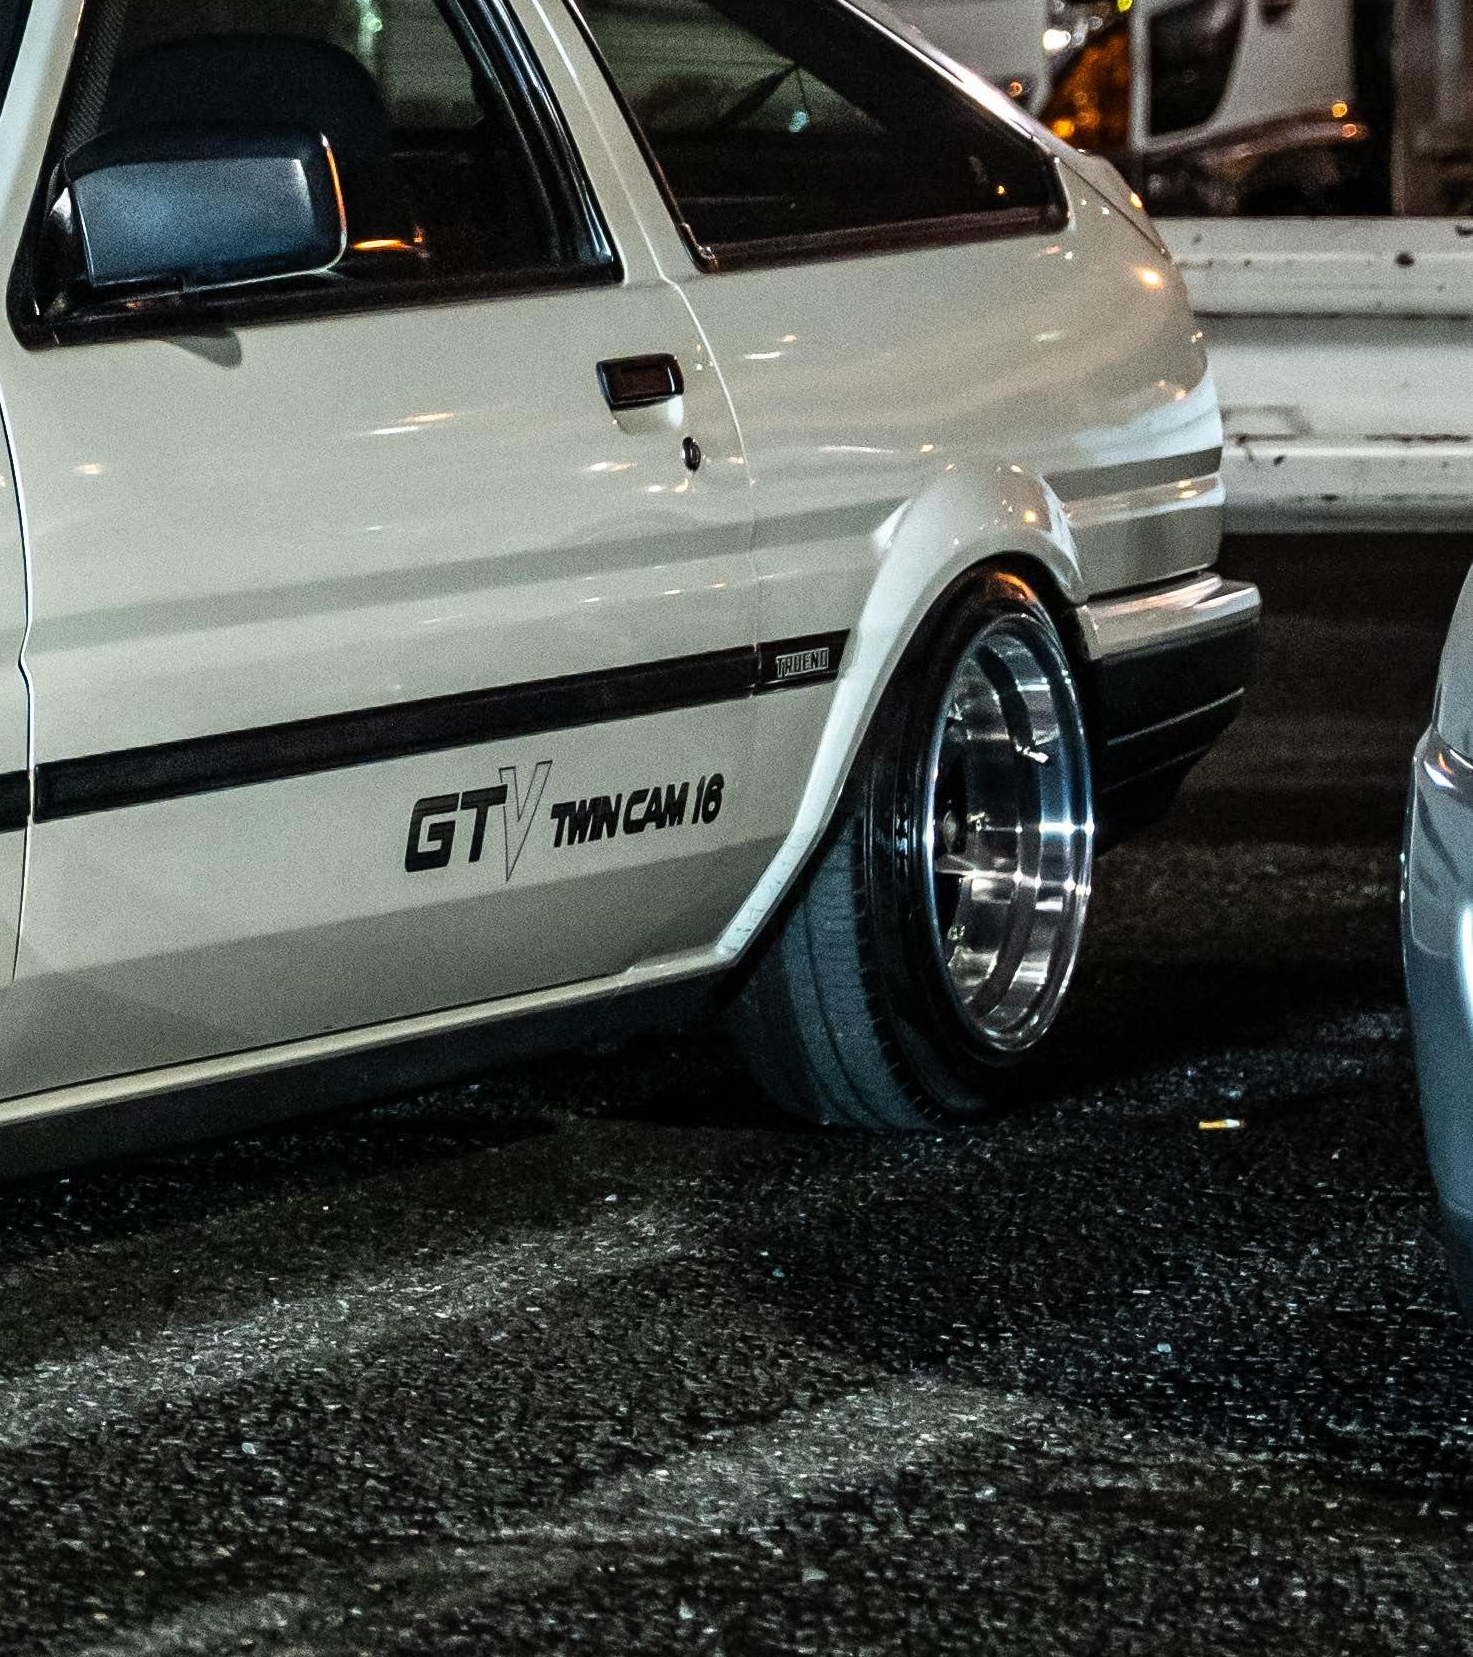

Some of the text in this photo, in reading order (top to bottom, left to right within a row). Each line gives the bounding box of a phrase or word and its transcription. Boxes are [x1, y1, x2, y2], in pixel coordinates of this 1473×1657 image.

[776, 647, 830, 678] TRUENO
[551, 793, 623, 848] TWIN
[623, 782, 690, 835] CAM
[691, 773, 726, 825] 16
